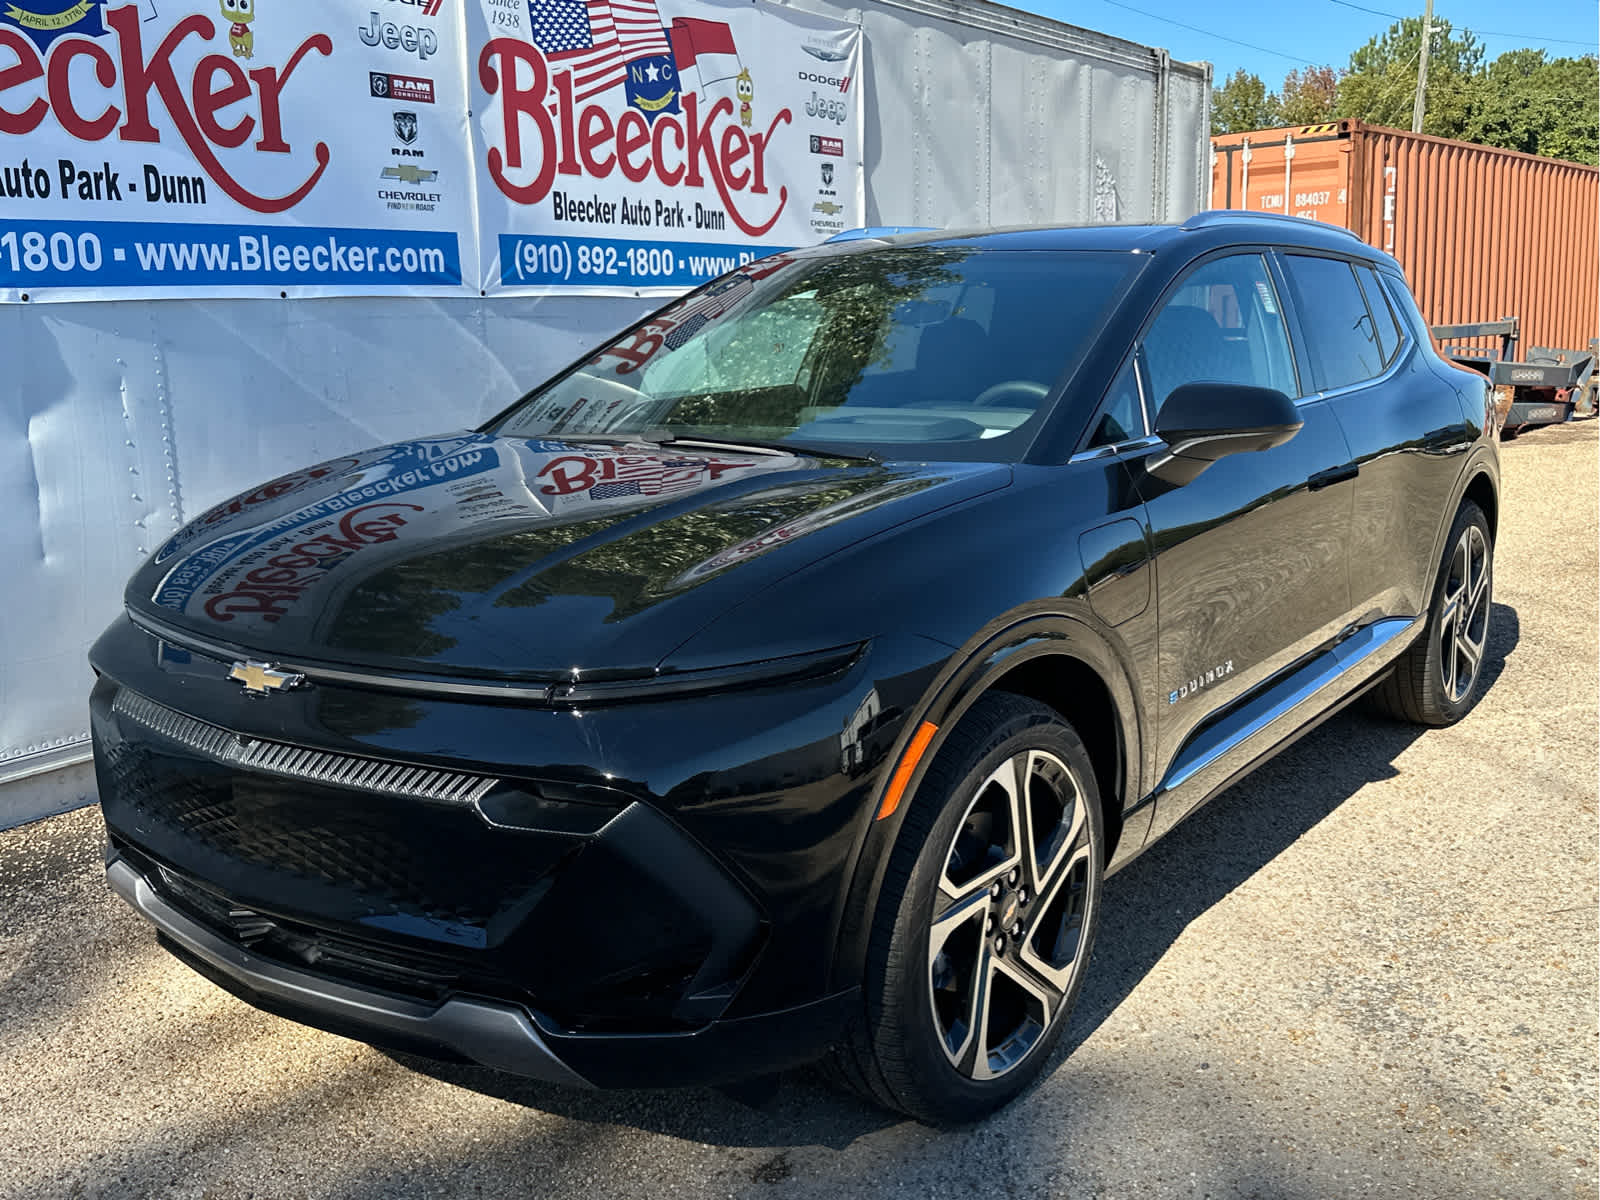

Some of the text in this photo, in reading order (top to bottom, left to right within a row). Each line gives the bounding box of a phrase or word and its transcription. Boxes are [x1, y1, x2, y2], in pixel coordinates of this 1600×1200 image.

[21, 14, 49, 27] APRIL
[64, 8, 82, 22] 1776
[492, 10, 520, 28] 1938
[358, 11, 438, 60] Jeep
[631, 64, 673, 84] N C
[798, 71, 844, 87] DODGE
[393, 79, 431, 92] RAM
[804, 91, 848, 126] Jeep
[478, 37, 792, 237] Bleecker
[822, 139, 842, 148] RAM
[391, 147, 424, 157] RAM
[0, 158, 207, 204] uto Park Dunn
[378, 190, 442, 202] CHEVROLET
[1260, 194, 1283, 209] TCNU
[1295, 191, 1331, 208] 884037
[553, 191, 725, 231] Bleecker Auto Park Dunn
[134, 234, 445, 274] www.Bleecker.com
[514, 239, 572, 281] (910)
[577, 244, 674, 277] 892-1800
[1168, 660, 1234, 704] EQUINOX
